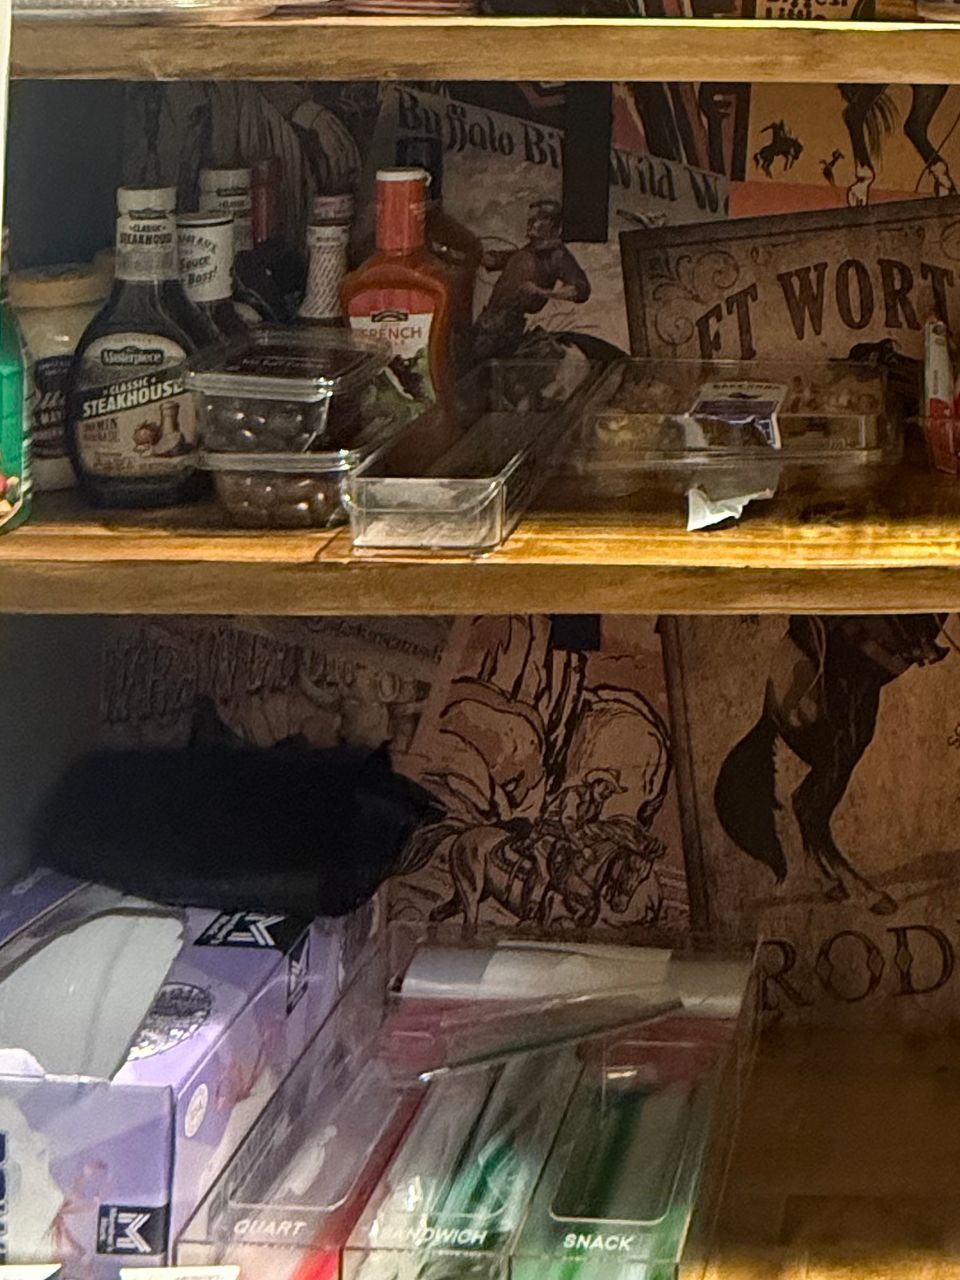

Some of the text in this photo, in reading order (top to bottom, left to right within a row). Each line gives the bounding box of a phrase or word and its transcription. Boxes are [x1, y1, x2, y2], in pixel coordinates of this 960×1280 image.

[103, 351, 163, 365] Masterpiece
[110, 377, 149, 395] CLASSIC
[82, 379, 185, 418] STEAKHOUSE
[233, 1220, 307, 1237] QUART
[562, 1232, 635, 1252] SNACK
